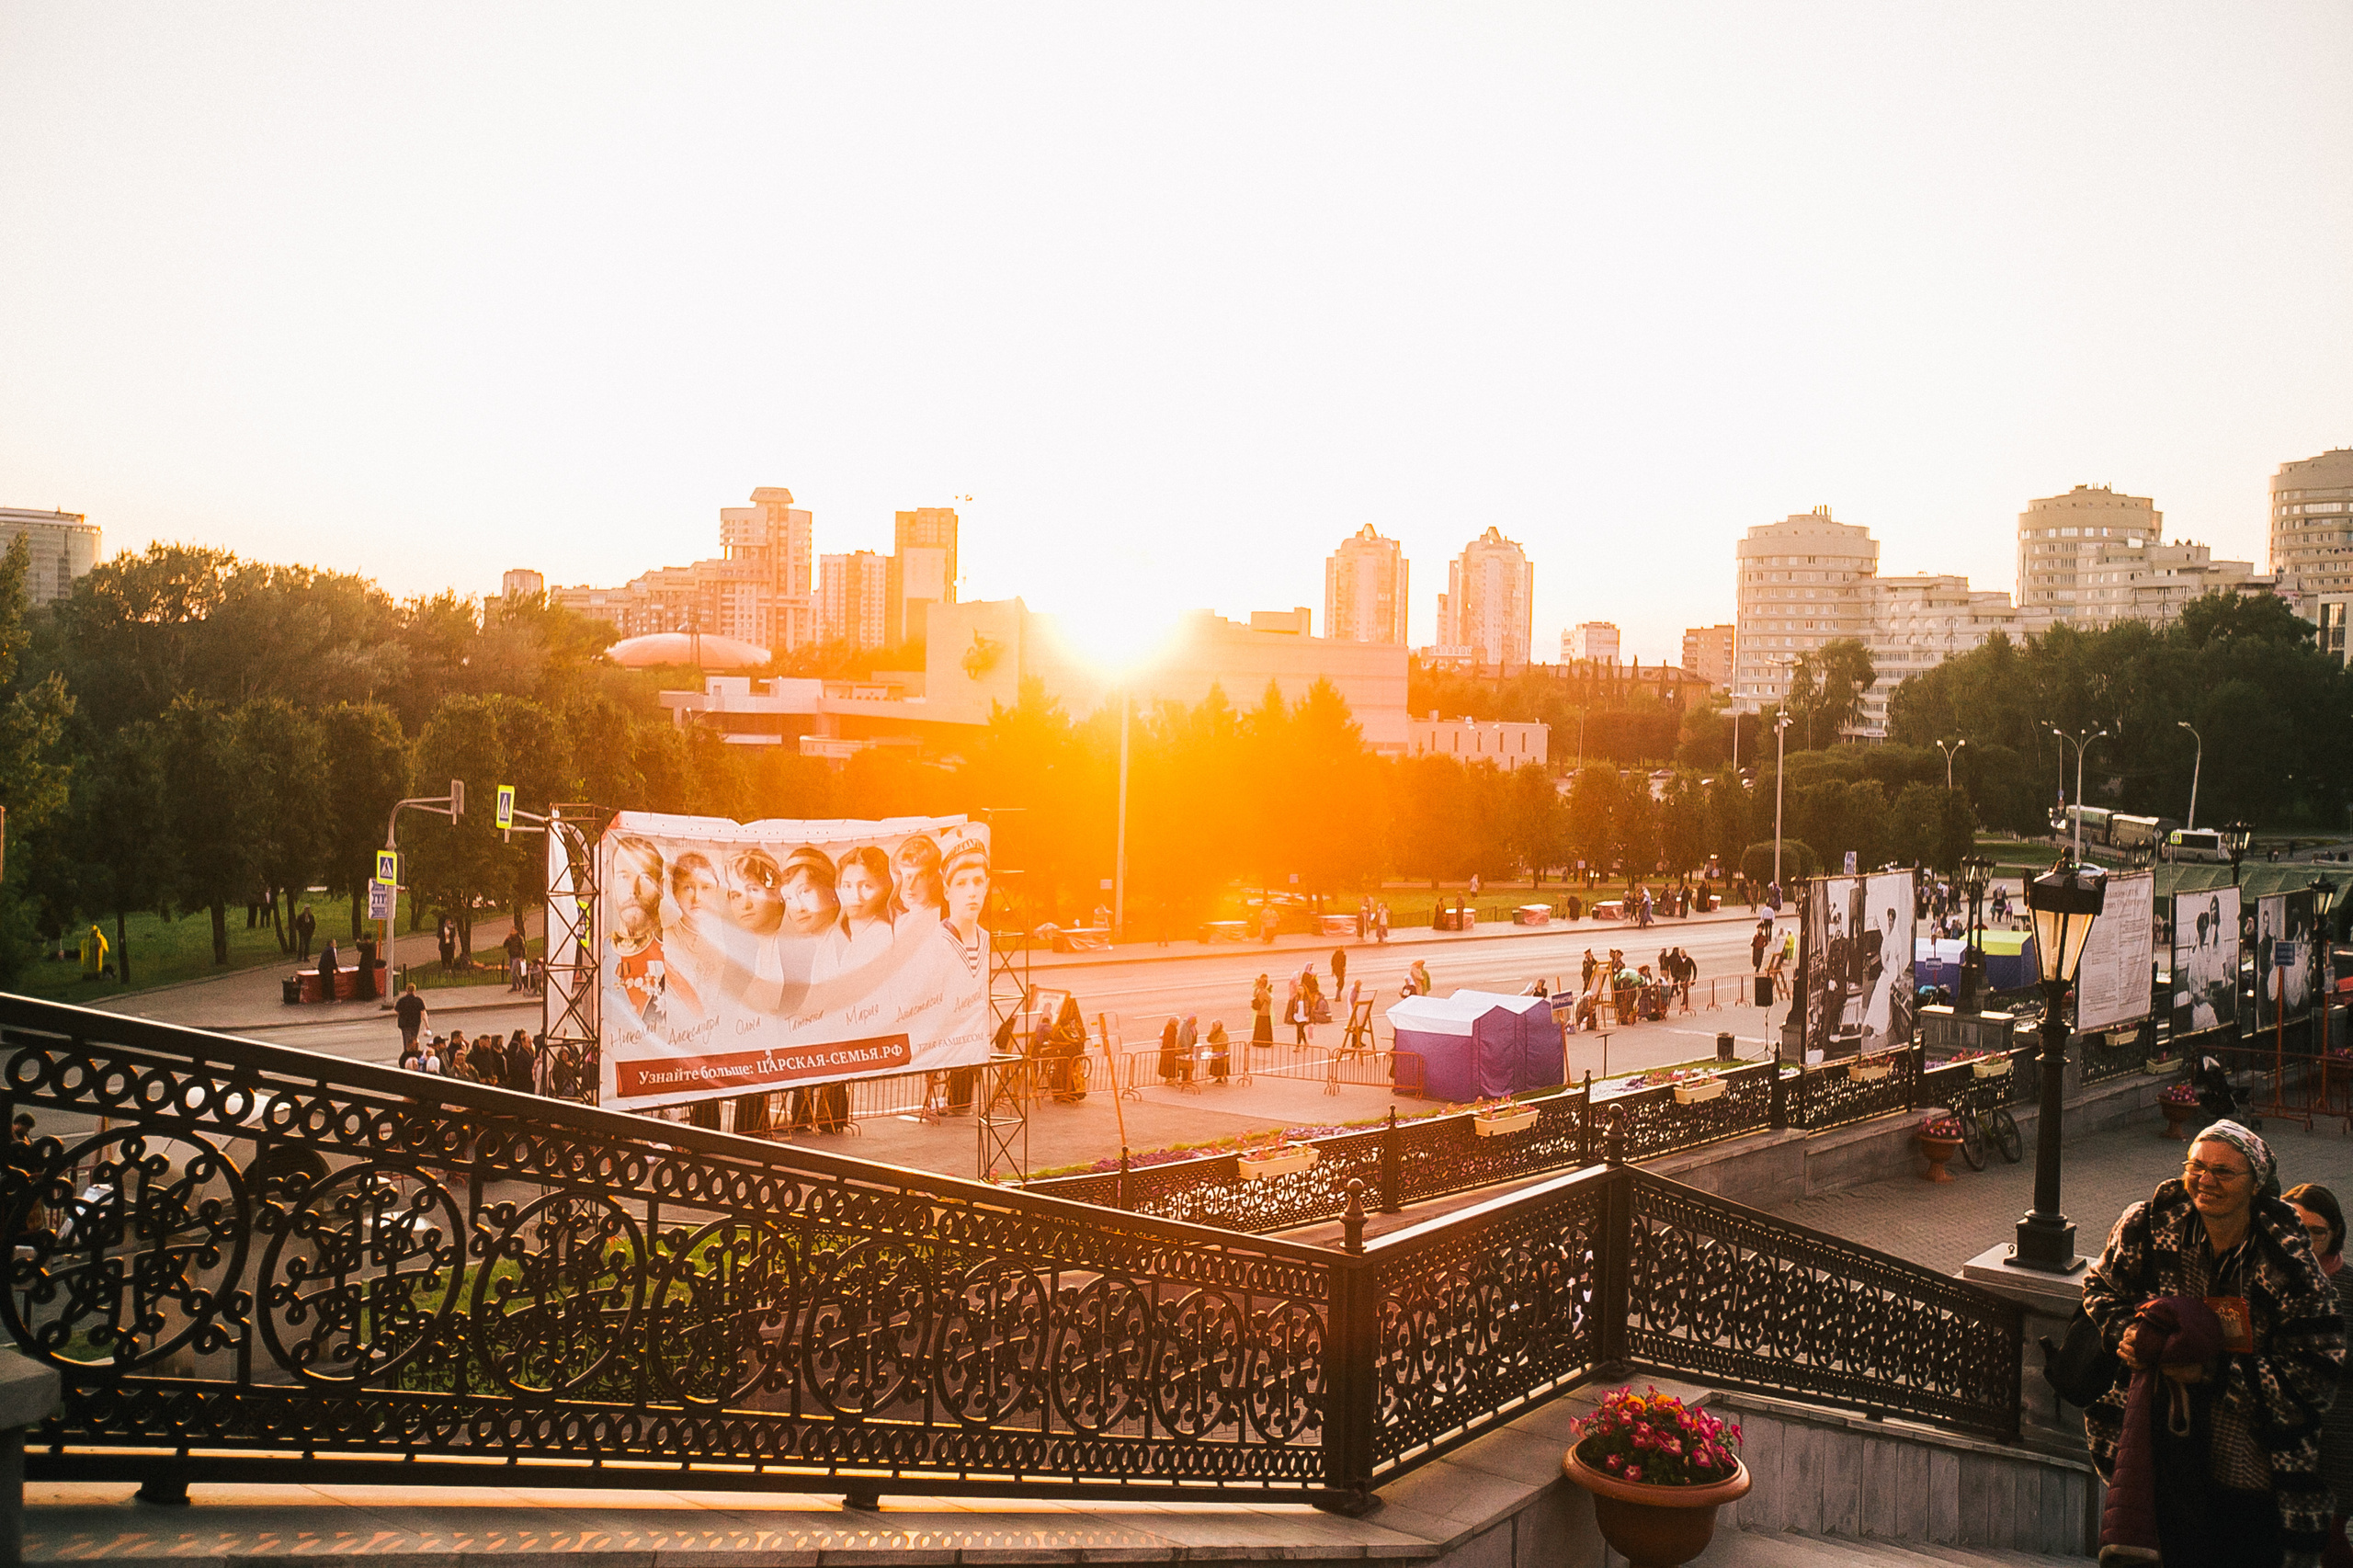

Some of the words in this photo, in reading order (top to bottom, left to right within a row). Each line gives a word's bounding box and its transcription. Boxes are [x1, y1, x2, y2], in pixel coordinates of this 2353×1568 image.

[638, 1067, 699, 1085] Узнайте
[700, 1065, 755, 1079] больше:
[756, 1045, 904, 1075] ЦАРСКАЯ-СЕМЬЯ.РФ
